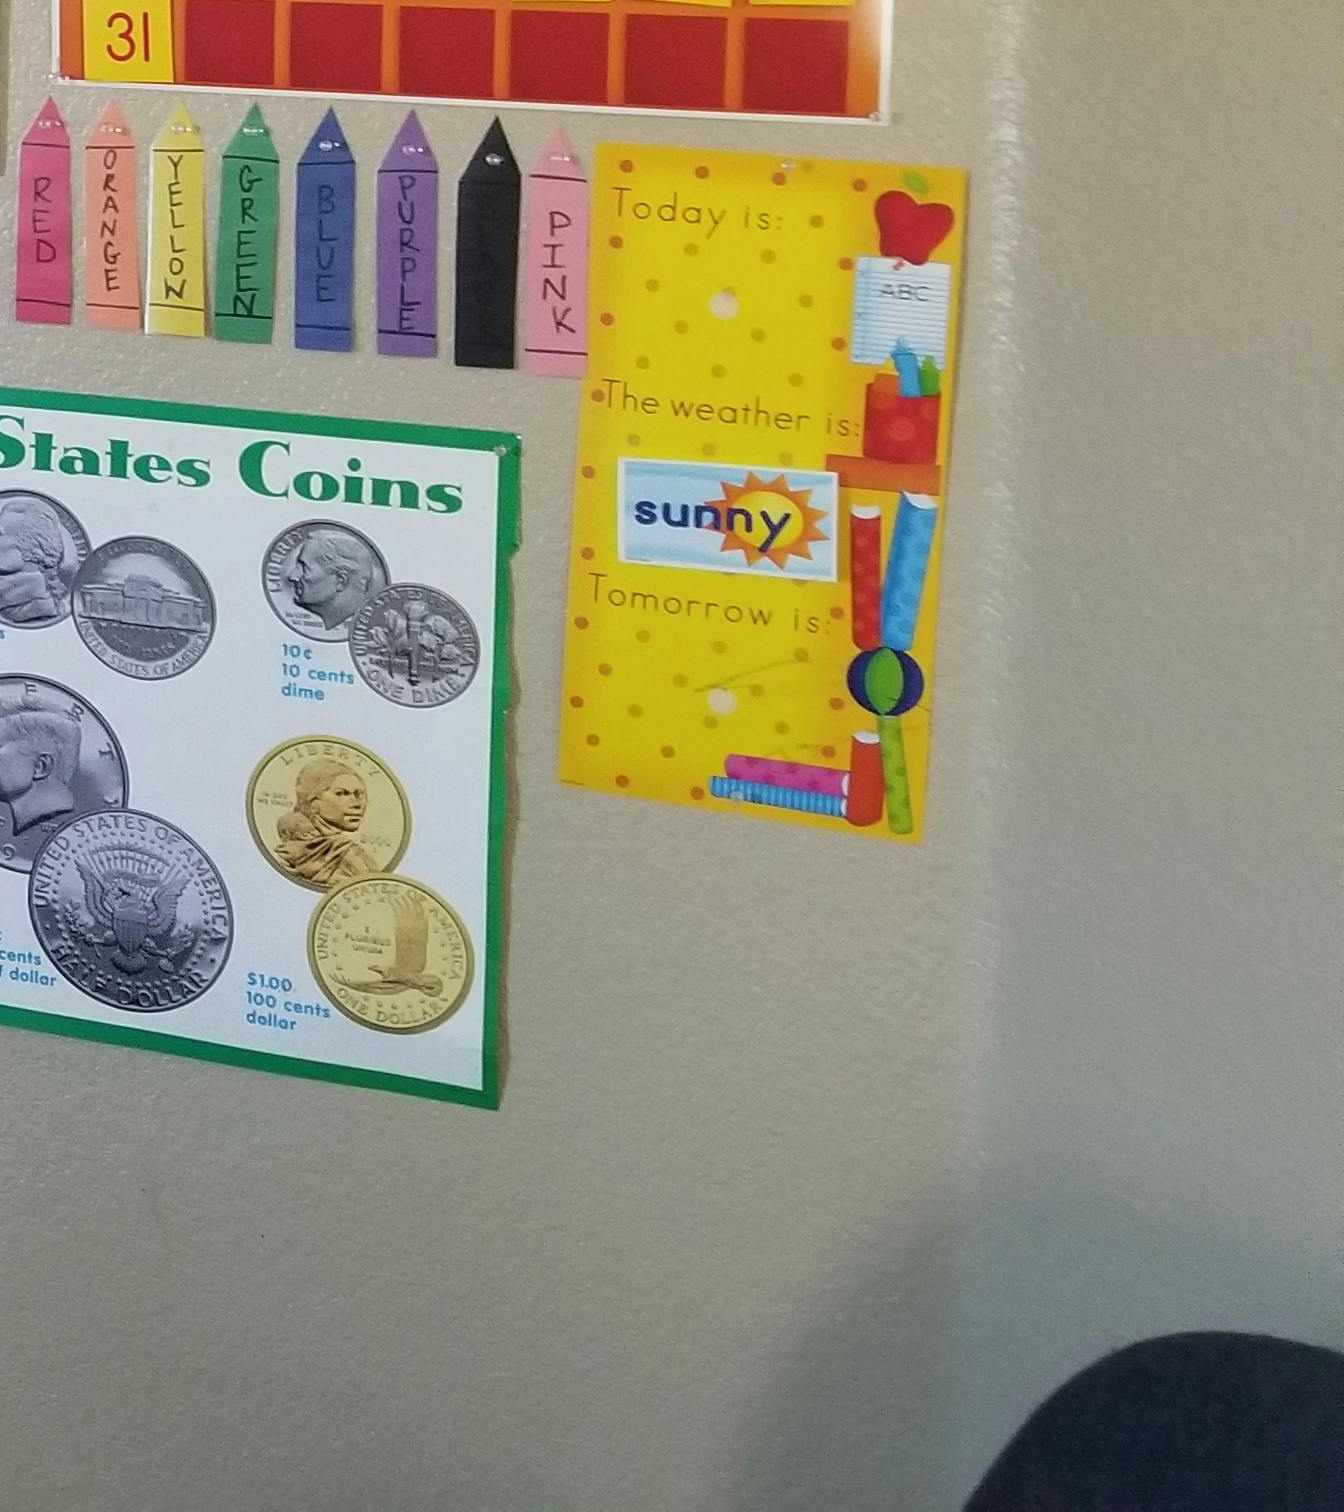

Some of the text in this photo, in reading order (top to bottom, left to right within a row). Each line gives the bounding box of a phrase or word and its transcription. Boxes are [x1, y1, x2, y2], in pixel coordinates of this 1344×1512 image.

[106, 12, 150, 62] 31
[33, 177, 56, 263] RED
[101, 150, 121, 291] ORANGE
[613, 188, 783, 237] Today is:
[234, 166, 261, 316] GREEN
[542, 212, 575, 333] PINK
[603, 379, 810, 432] The weather
[238, 439, 464, 515] Coins
[635, 496, 791, 553] sunny
[589, 573, 771, 626] Tomorrow
[281, 682, 325, 701] dime
[10, 967, 56, 987] dollar
[247, 973, 292, 991] $1.00
